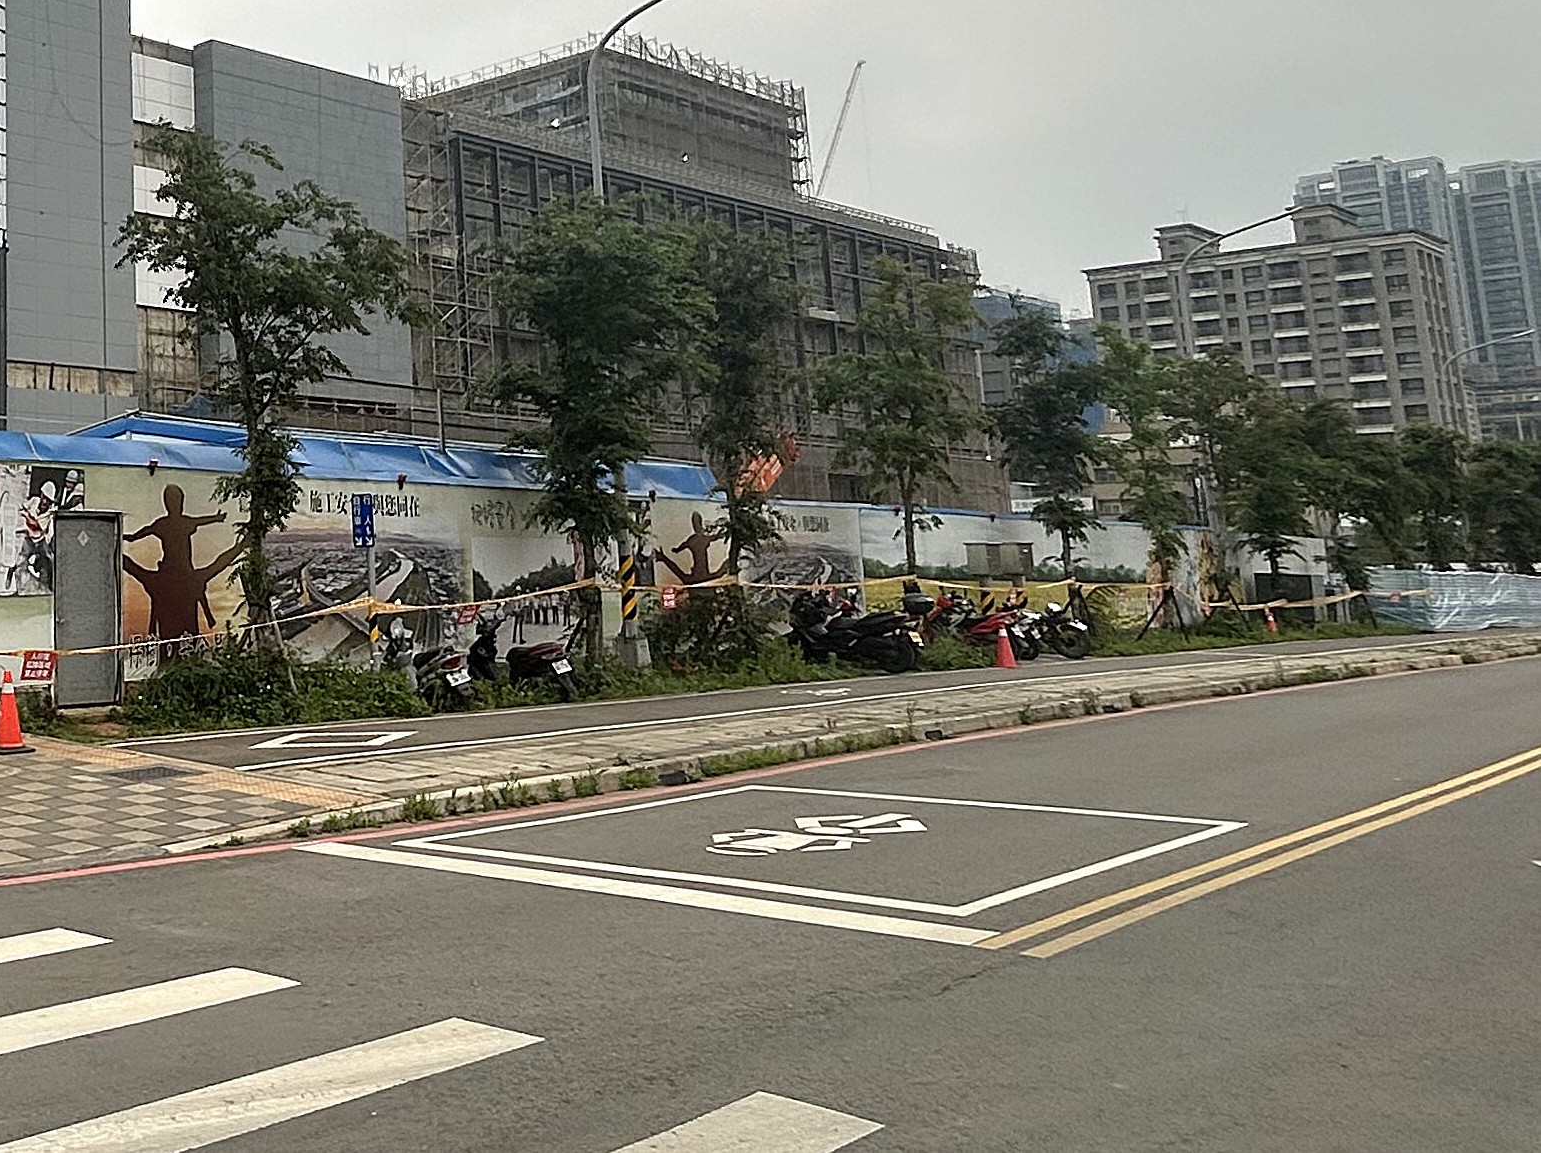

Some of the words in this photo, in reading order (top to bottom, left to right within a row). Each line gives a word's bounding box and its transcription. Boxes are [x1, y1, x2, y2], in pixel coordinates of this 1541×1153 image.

[309, 489, 421, 518] 施工安與您同在
